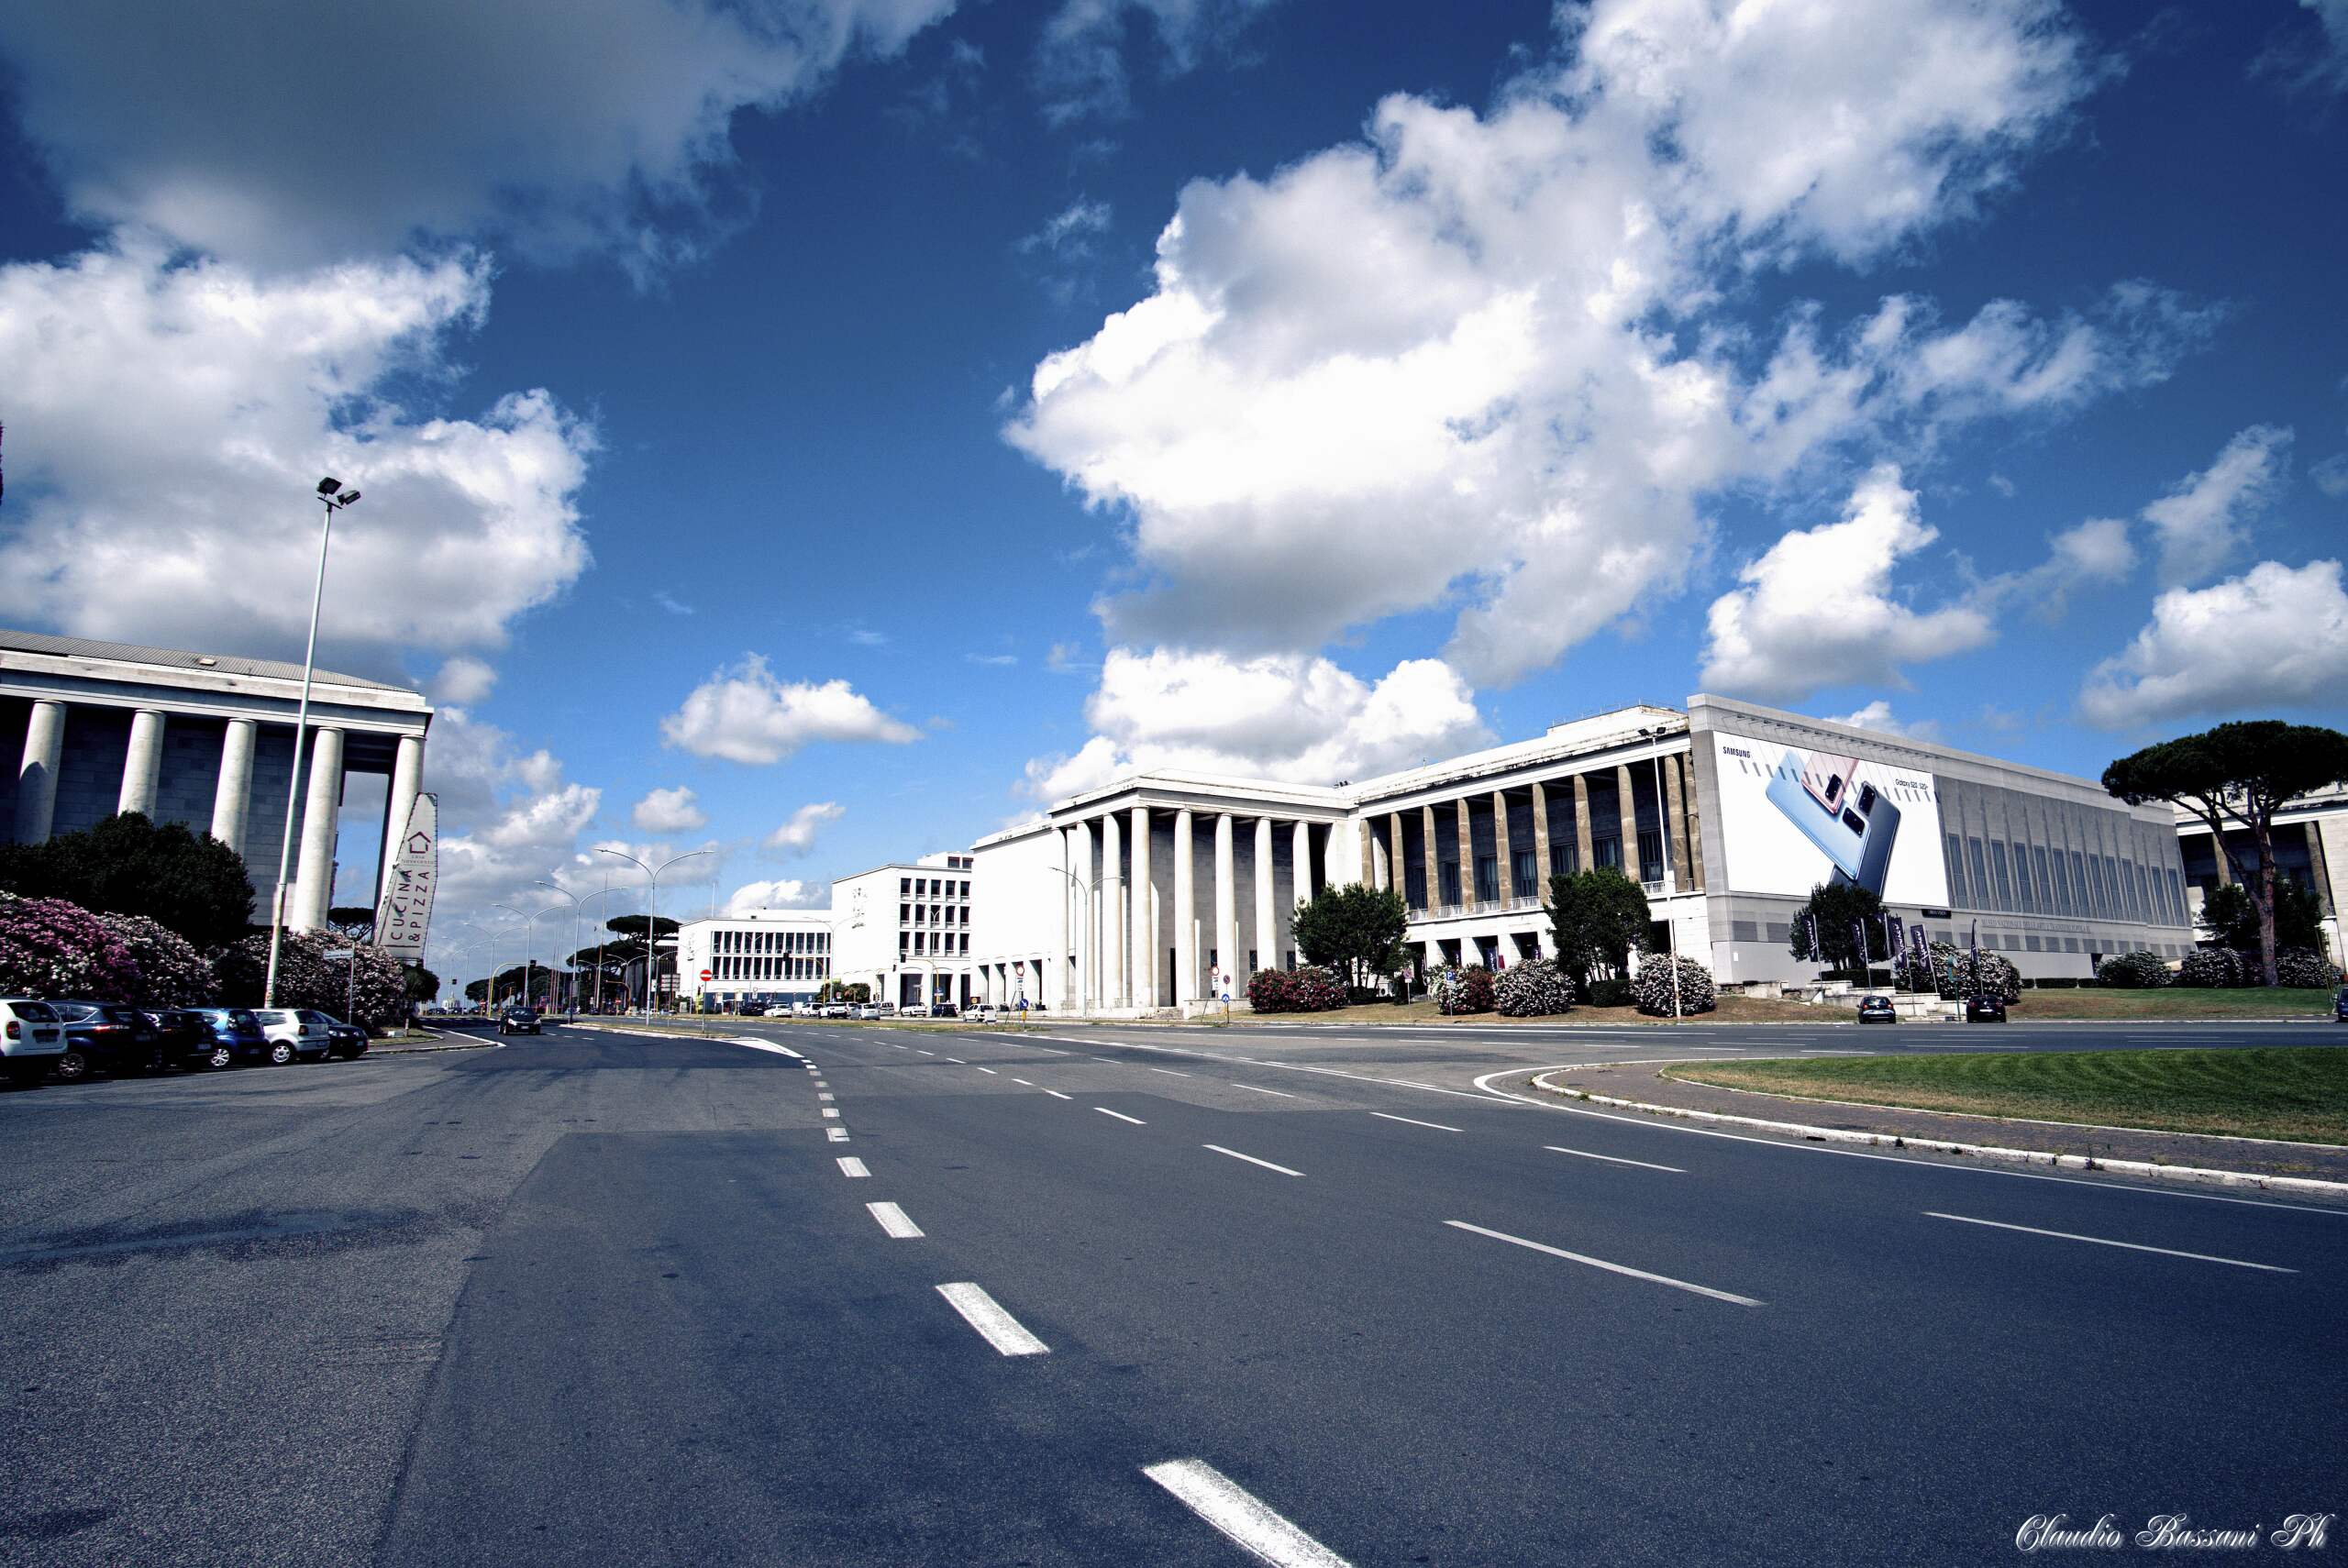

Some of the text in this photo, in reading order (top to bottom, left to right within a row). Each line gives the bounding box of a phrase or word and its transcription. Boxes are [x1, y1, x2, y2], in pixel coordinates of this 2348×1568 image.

[1723, 746, 1751, 758] SAMSUNG
[391, 870, 412, 940] CUCINA
[408, 872, 429, 942] & PIZZA
[1447, 971, 1453, 979] P
